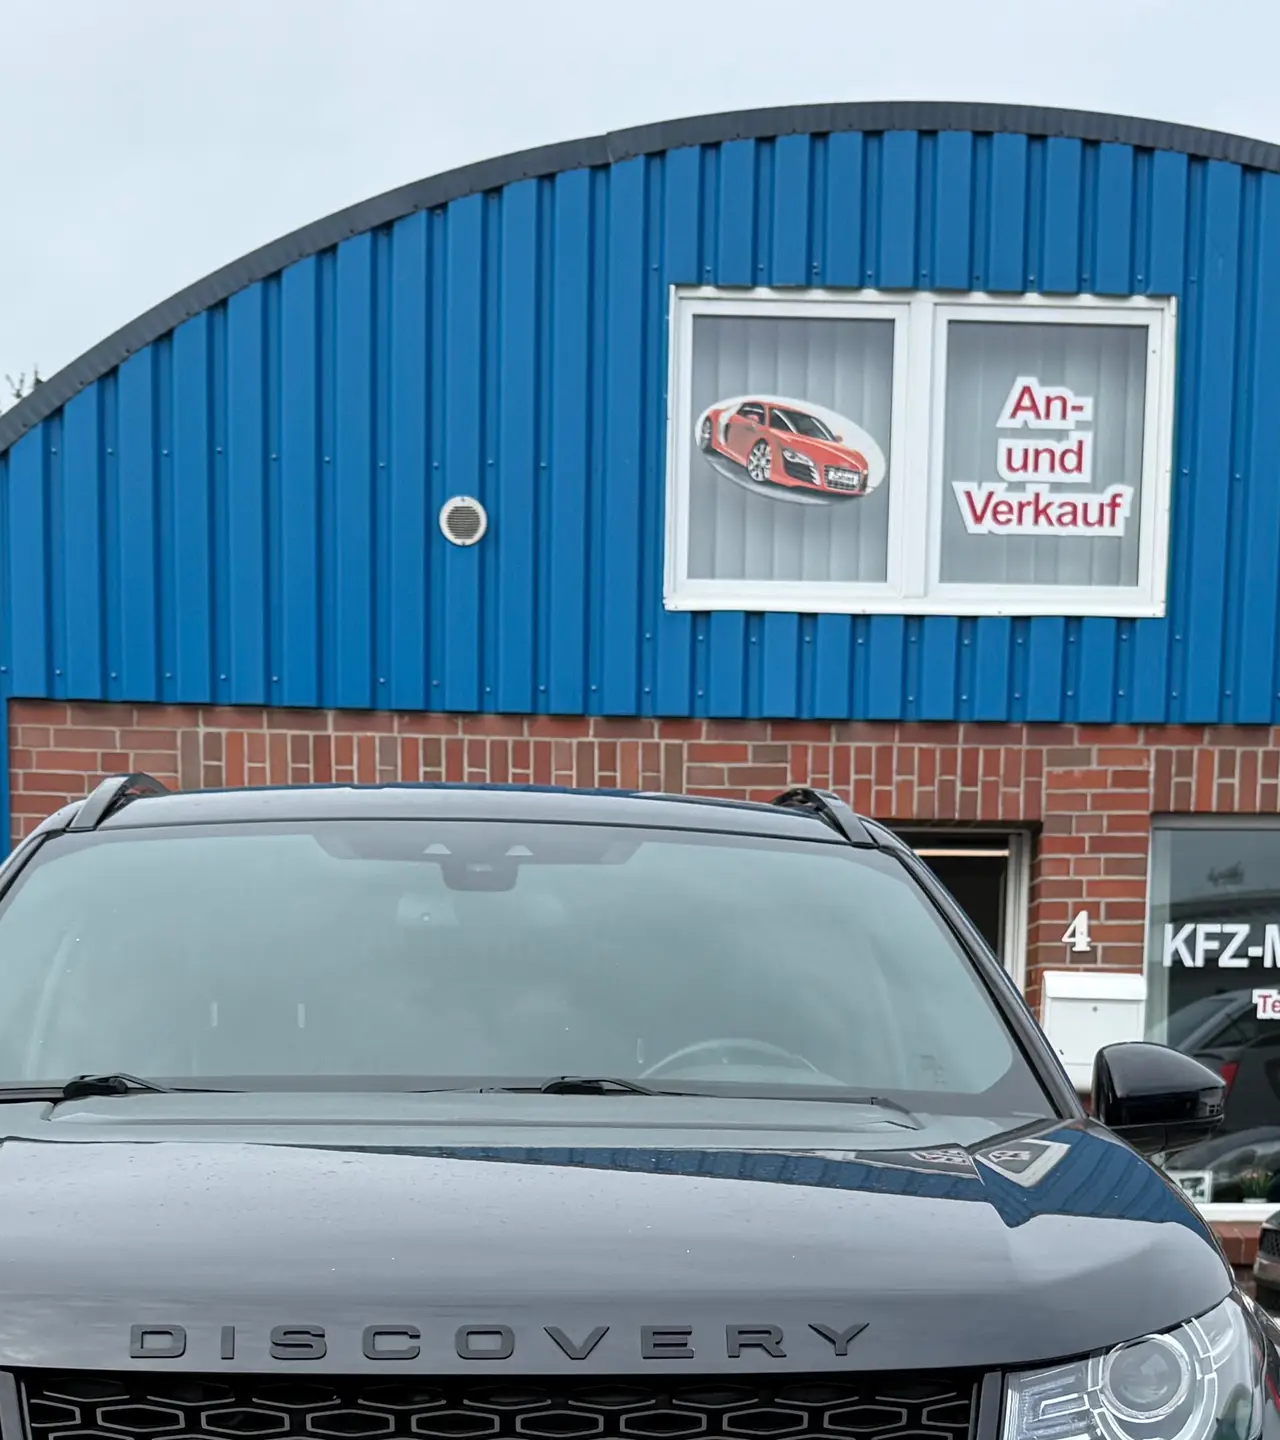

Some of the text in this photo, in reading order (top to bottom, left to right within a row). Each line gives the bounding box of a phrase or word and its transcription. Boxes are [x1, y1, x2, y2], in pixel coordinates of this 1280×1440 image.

[1009, 385, 1084, 420] An-
[1005, 440, 1084, 473] und
[964, 490, 1124, 527] Verkauf
[1061, 910, 1091, 953] 4
[129, 1323, 869, 1361] DISCOVERY
